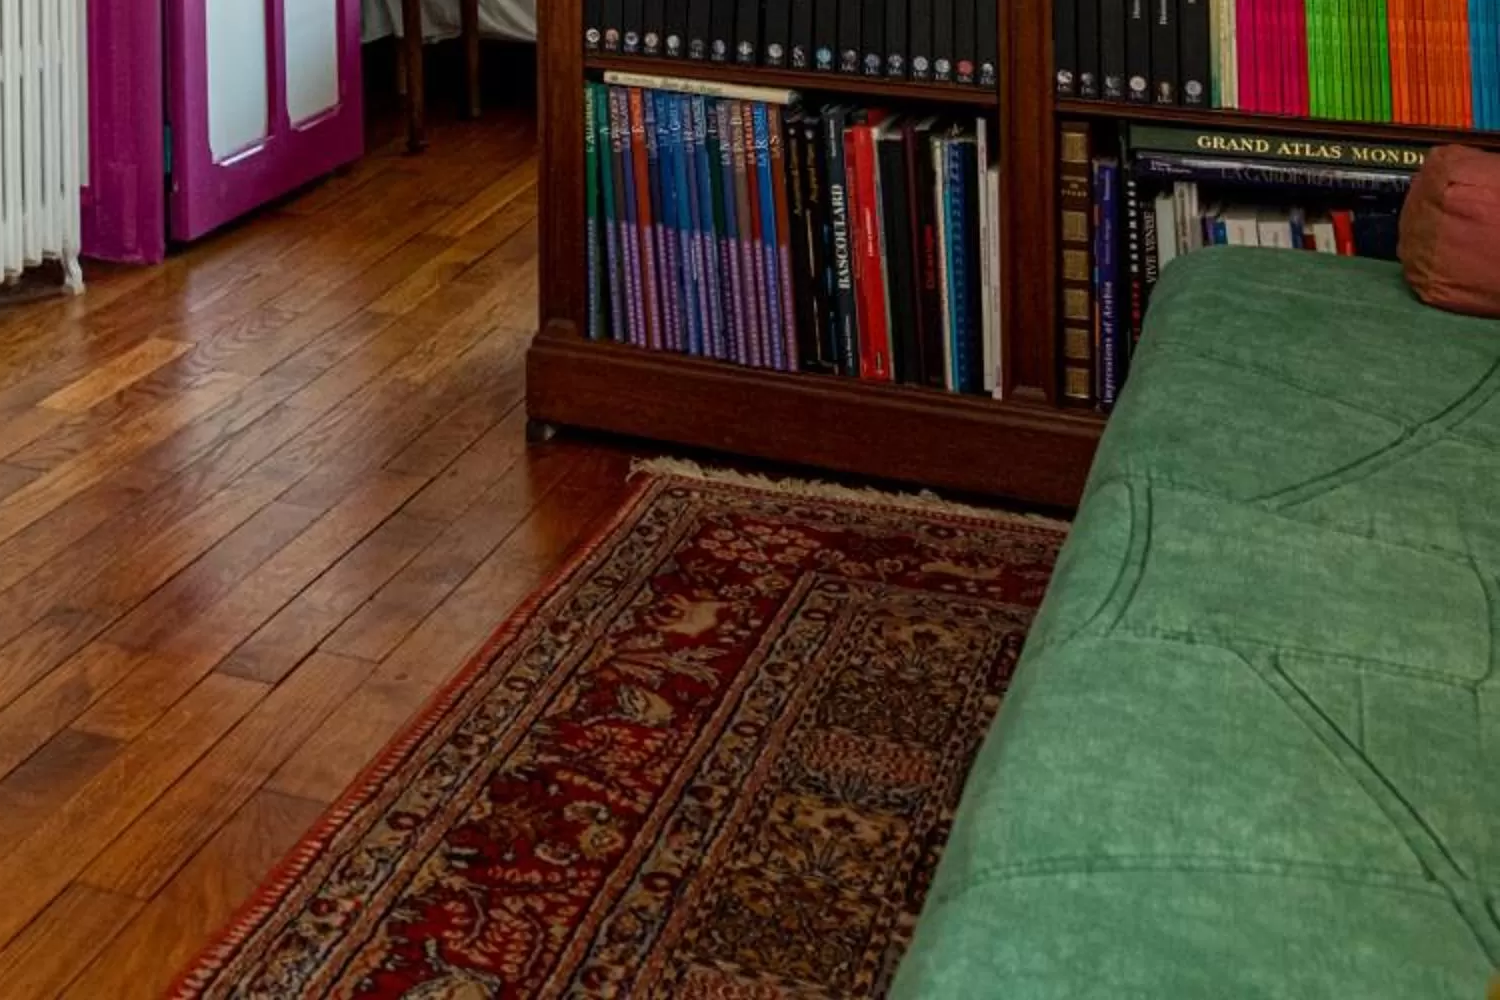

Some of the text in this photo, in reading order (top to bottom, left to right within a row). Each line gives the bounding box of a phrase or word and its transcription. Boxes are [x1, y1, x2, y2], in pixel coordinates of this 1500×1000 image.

[1197, 135, 1269, 153] GRAND
[1277, 141, 1342, 160] ATLAS
[831, 183, 851, 290] BASCOULARD
[1103, 337, 1116, 404] Impressions
